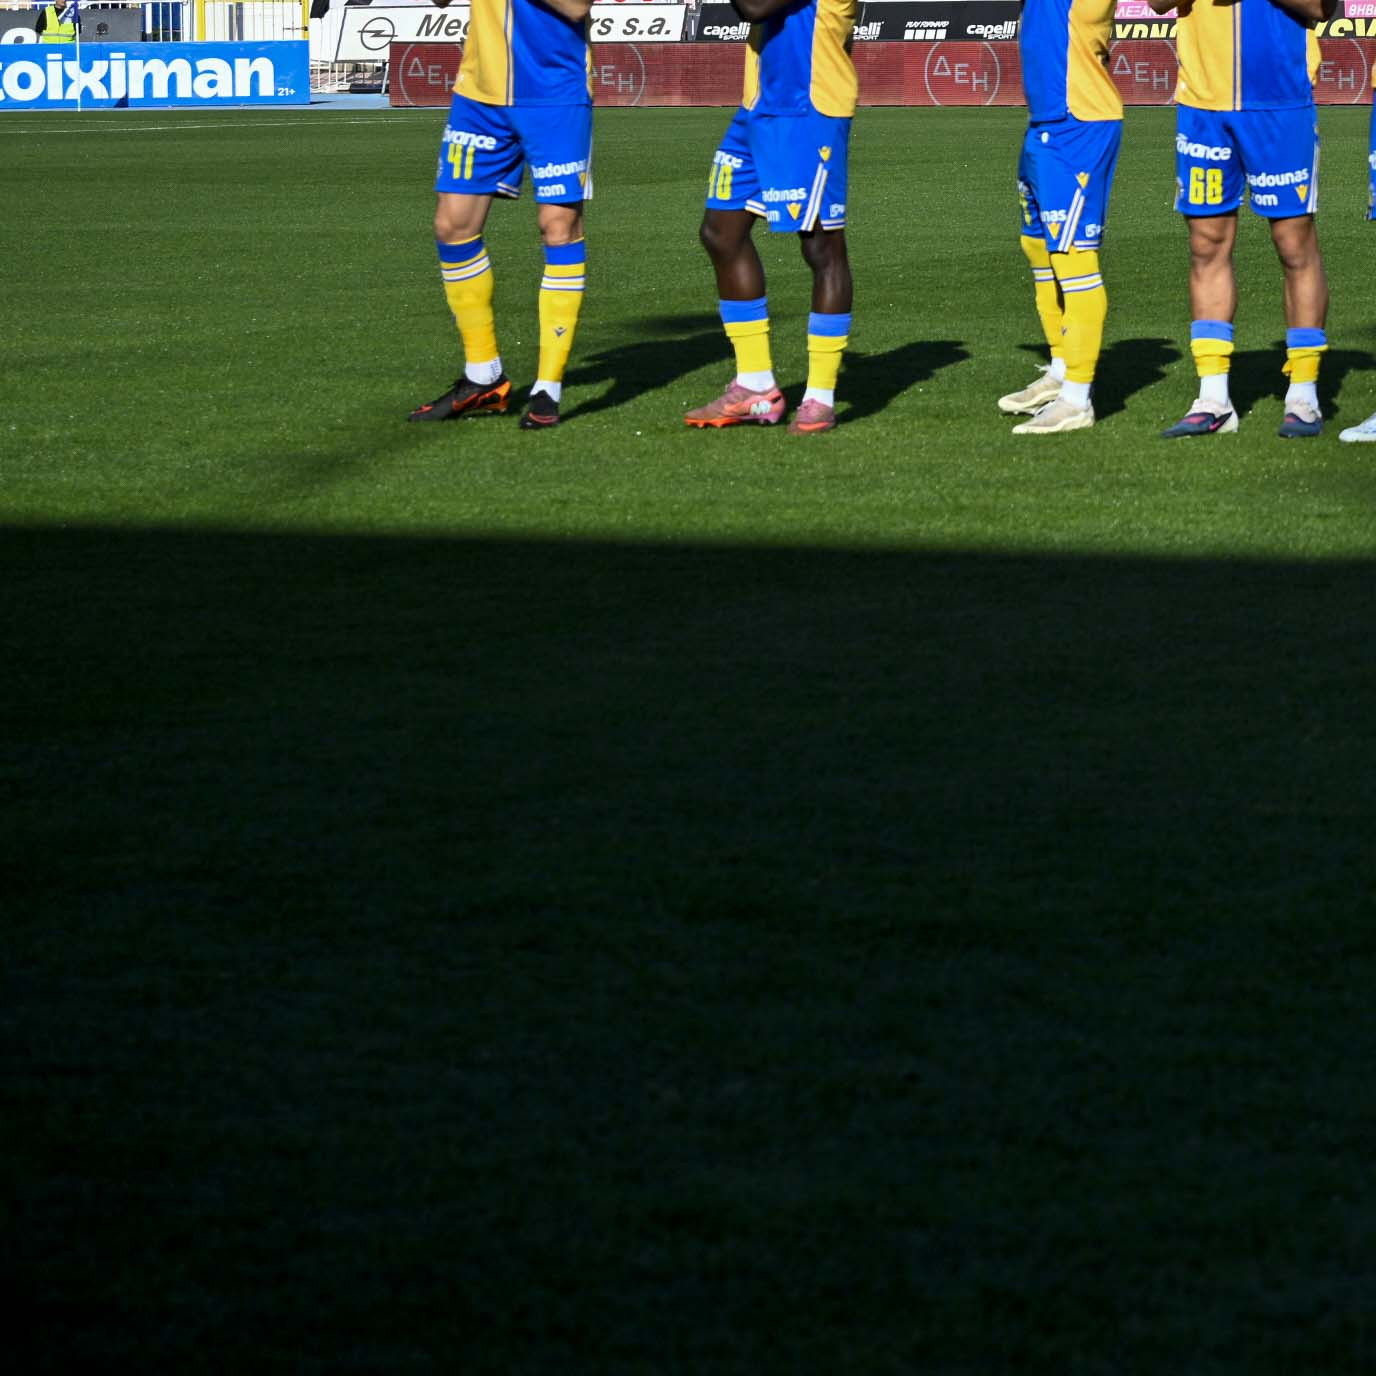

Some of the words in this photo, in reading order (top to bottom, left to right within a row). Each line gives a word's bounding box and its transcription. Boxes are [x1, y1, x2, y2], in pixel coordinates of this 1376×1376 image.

[622, 17, 672, 36] s.a.
[703, 22, 751, 39] capelli
[853, 22, 883, 37] pelli
[966, 21, 1018, 38] capelli
[0, 51, 275, 102] oiximan
[594, 62, 635, 93] ΕΗ
[932, 55, 989, 93] ΔΕΗ
[1112, 53, 1170, 91] ΔΕΗ
[1320, 60, 1355, 90] ΕΗ
[277, 86, 296, 97] 21+
[447, 143, 476, 181] 41
[1188, 166, 1224, 206] 68
[1247, 167, 1310, 188] adounas
